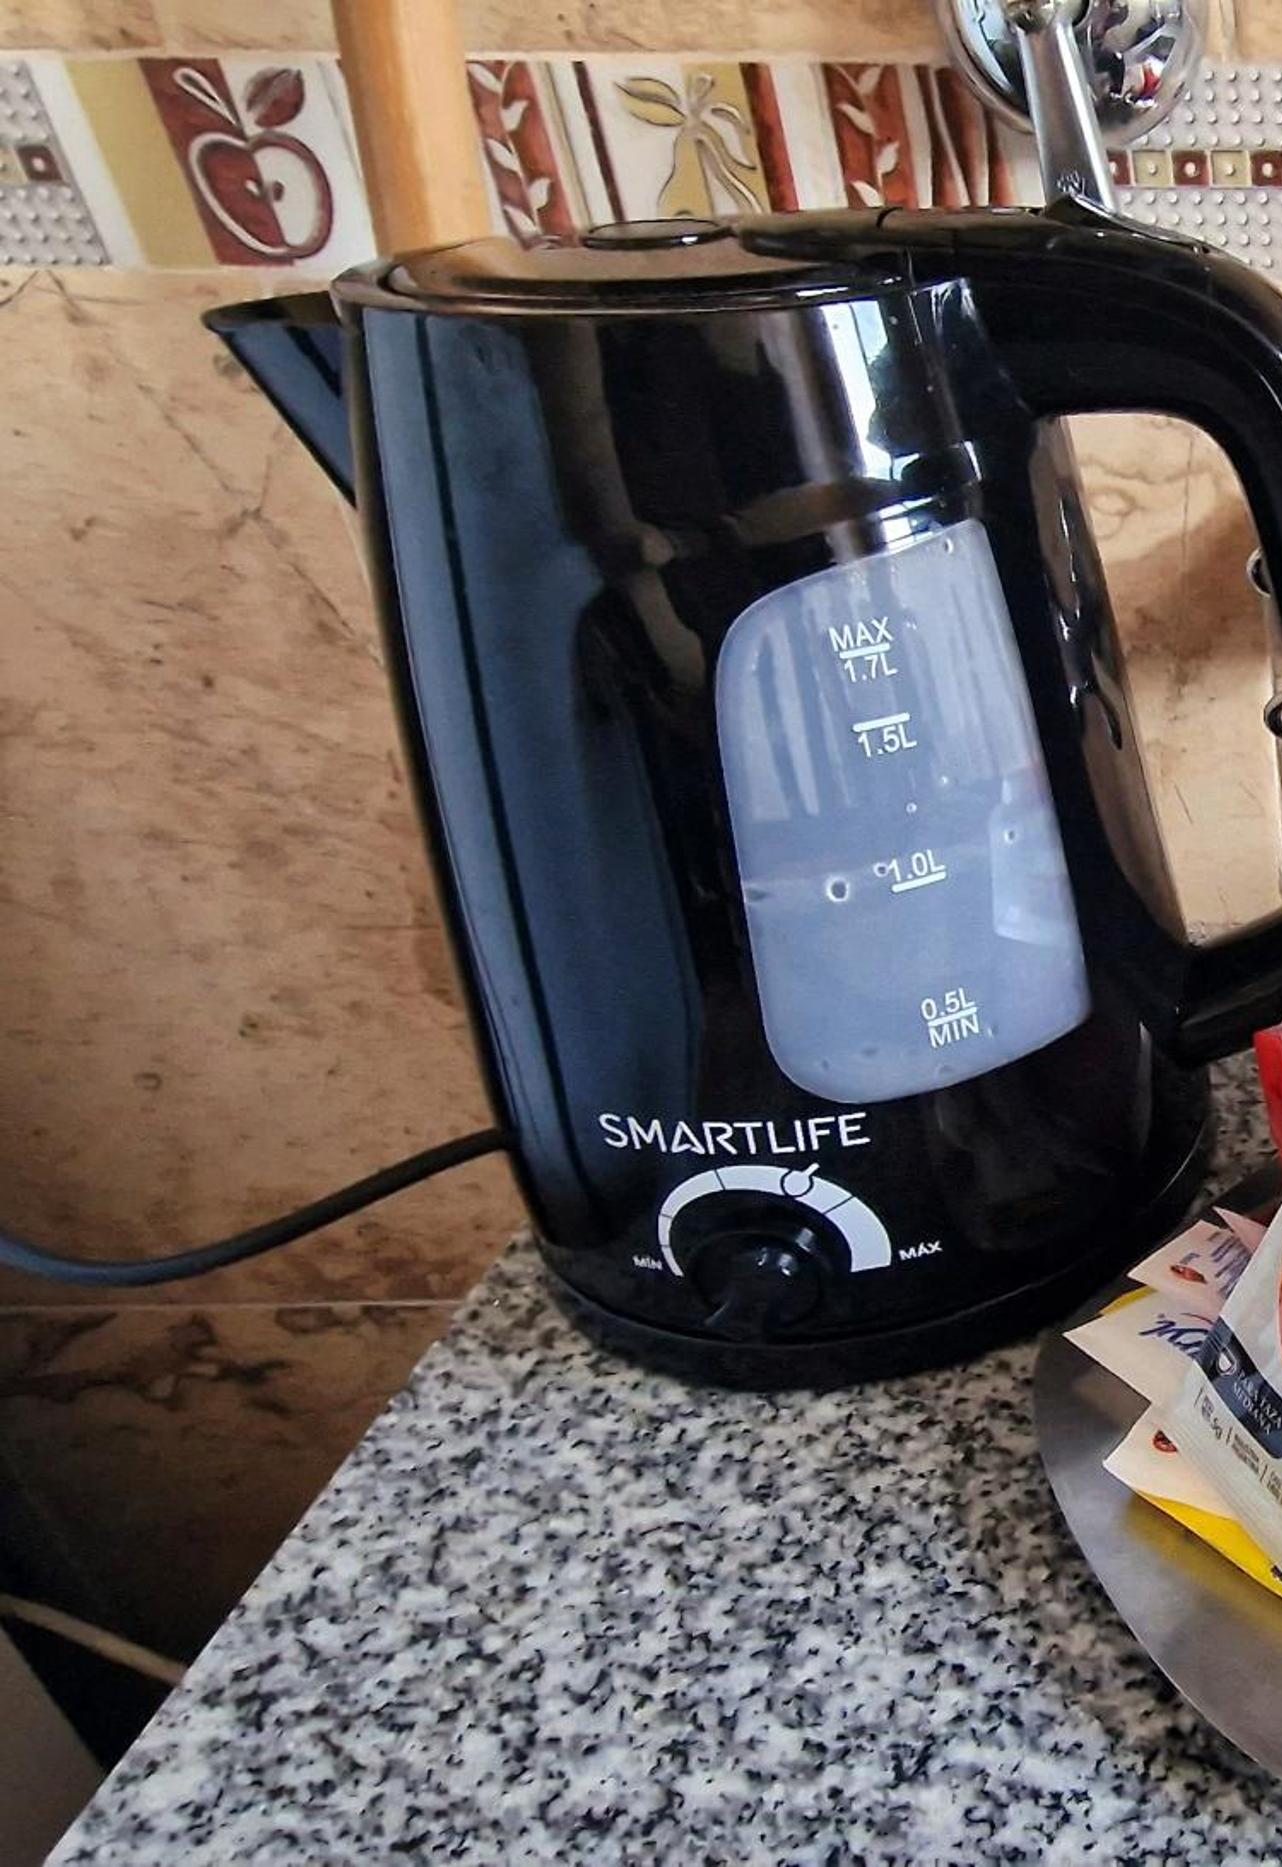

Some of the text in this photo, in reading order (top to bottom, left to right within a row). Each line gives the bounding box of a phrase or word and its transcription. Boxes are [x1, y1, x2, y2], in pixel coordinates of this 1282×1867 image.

[829, 616, 894, 652] MAX
[844, 655, 898, 683] 1.7L
[858, 724, 918, 758] 1.5L
[888, 849, 947, 882] 1.0L
[921, 988, 976, 1021] 0.5L
[929, 1013, 980, 1048] MIN
[598, 1112, 871, 1156] SMARTLIFE
[899, 1240, 943, 1261] MAX
